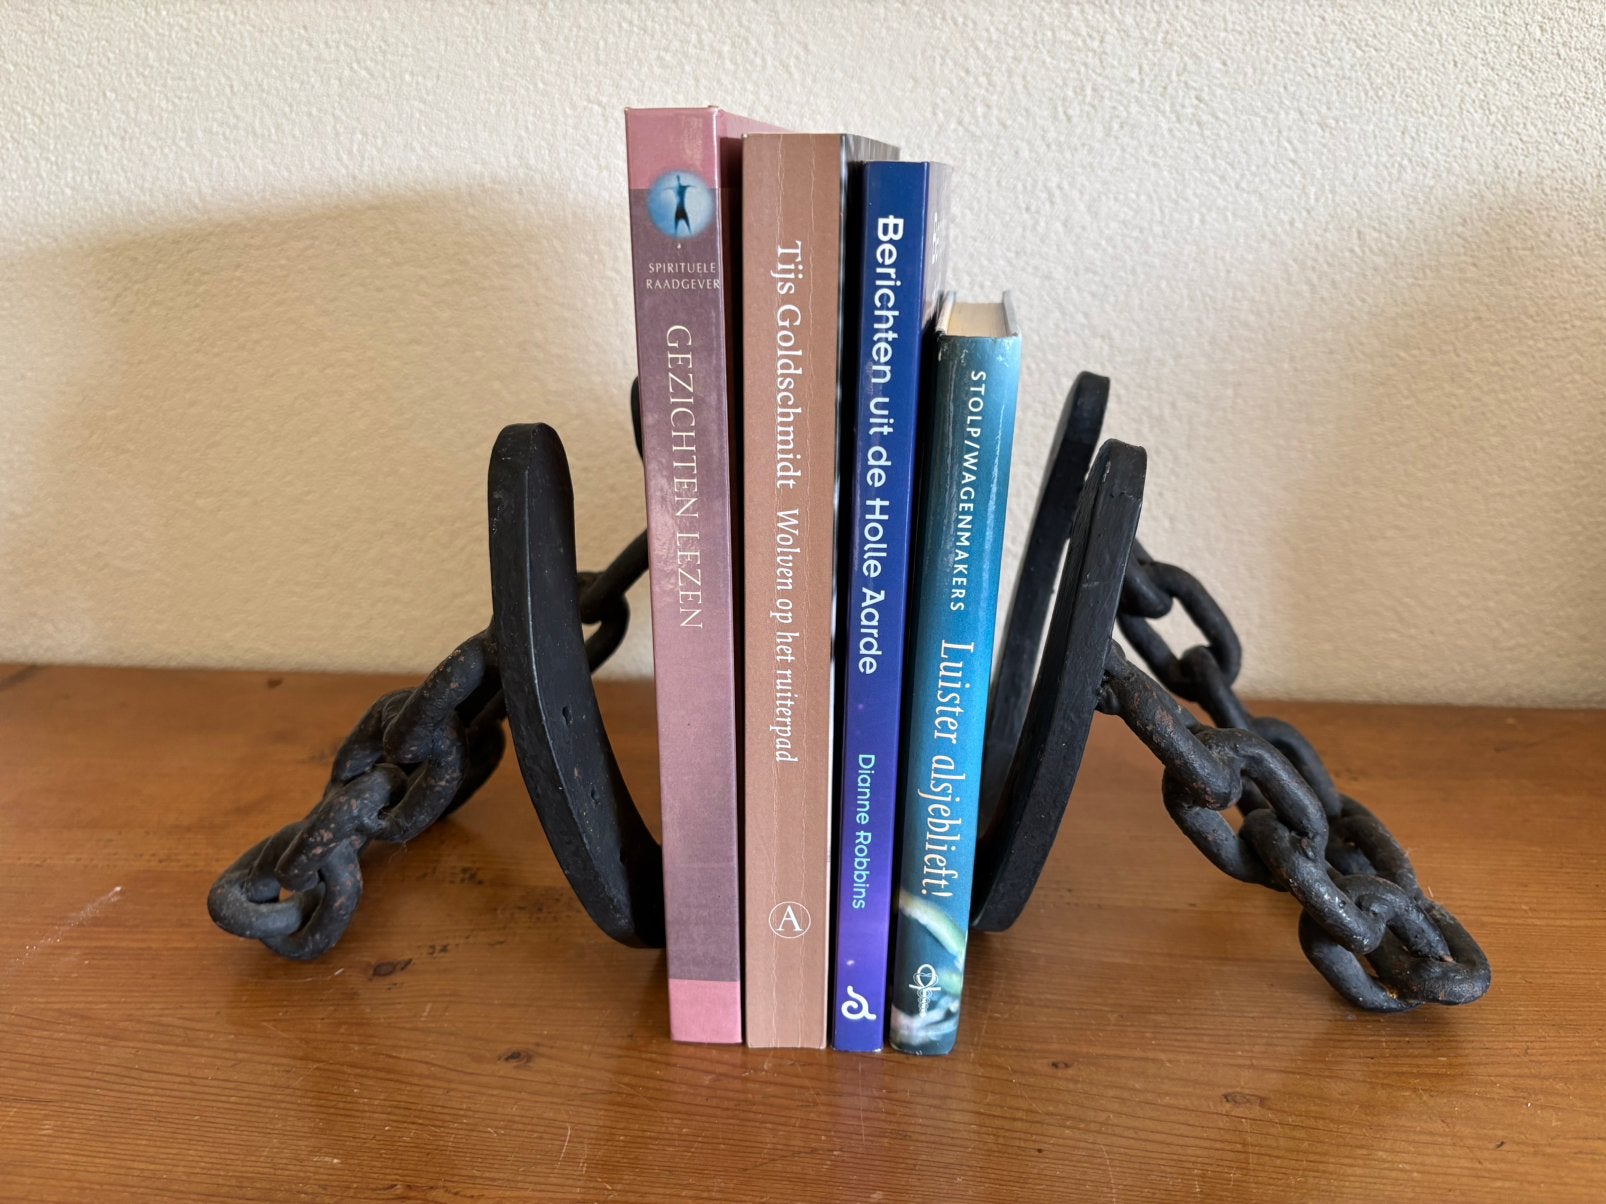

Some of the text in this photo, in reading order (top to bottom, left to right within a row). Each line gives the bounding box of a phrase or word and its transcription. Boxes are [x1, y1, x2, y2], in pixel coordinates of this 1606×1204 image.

[646, 278, 720, 290] RAADGEVER
[648, 262, 716, 274] SPIRITUELE
[666, 325, 704, 629] GEZICHTEN LEZEN
[770, 241, 804, 763] Tijs Goldschmidt Wolven op het ruiterpad
[858, 215, 904, 675] Berichten uit de Holle Aarde
[950, 370, 987, 611] STOLP/WAGENMAKERS
[852, 754, 876, 910] Dianne Robbins
[917, 640, 974, 898] Luister alsjeblieft!
